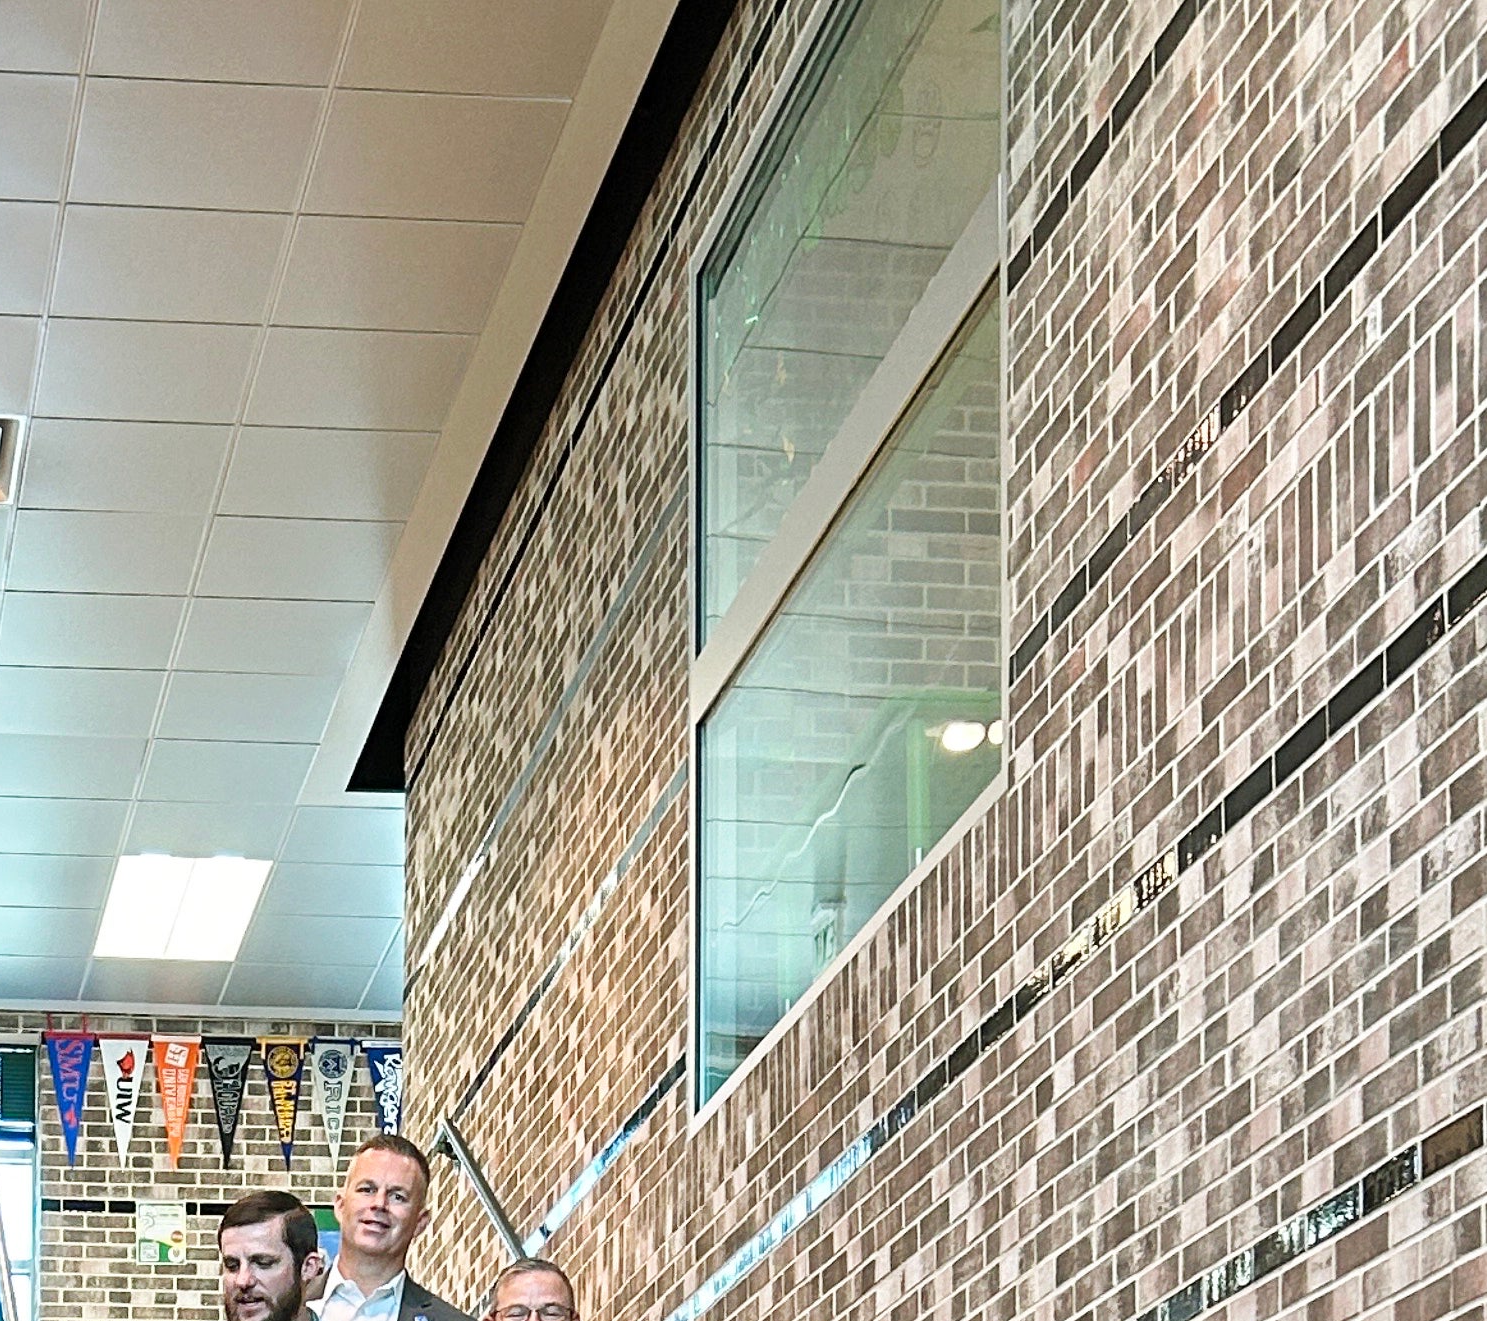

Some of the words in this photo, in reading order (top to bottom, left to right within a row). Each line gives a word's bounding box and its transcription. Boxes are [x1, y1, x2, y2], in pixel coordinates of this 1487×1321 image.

[55, 1039, 84, 1103] SMU
[115, 1077, 134, 1124] UIW
[324, 1081, 342, 1144] RICE
